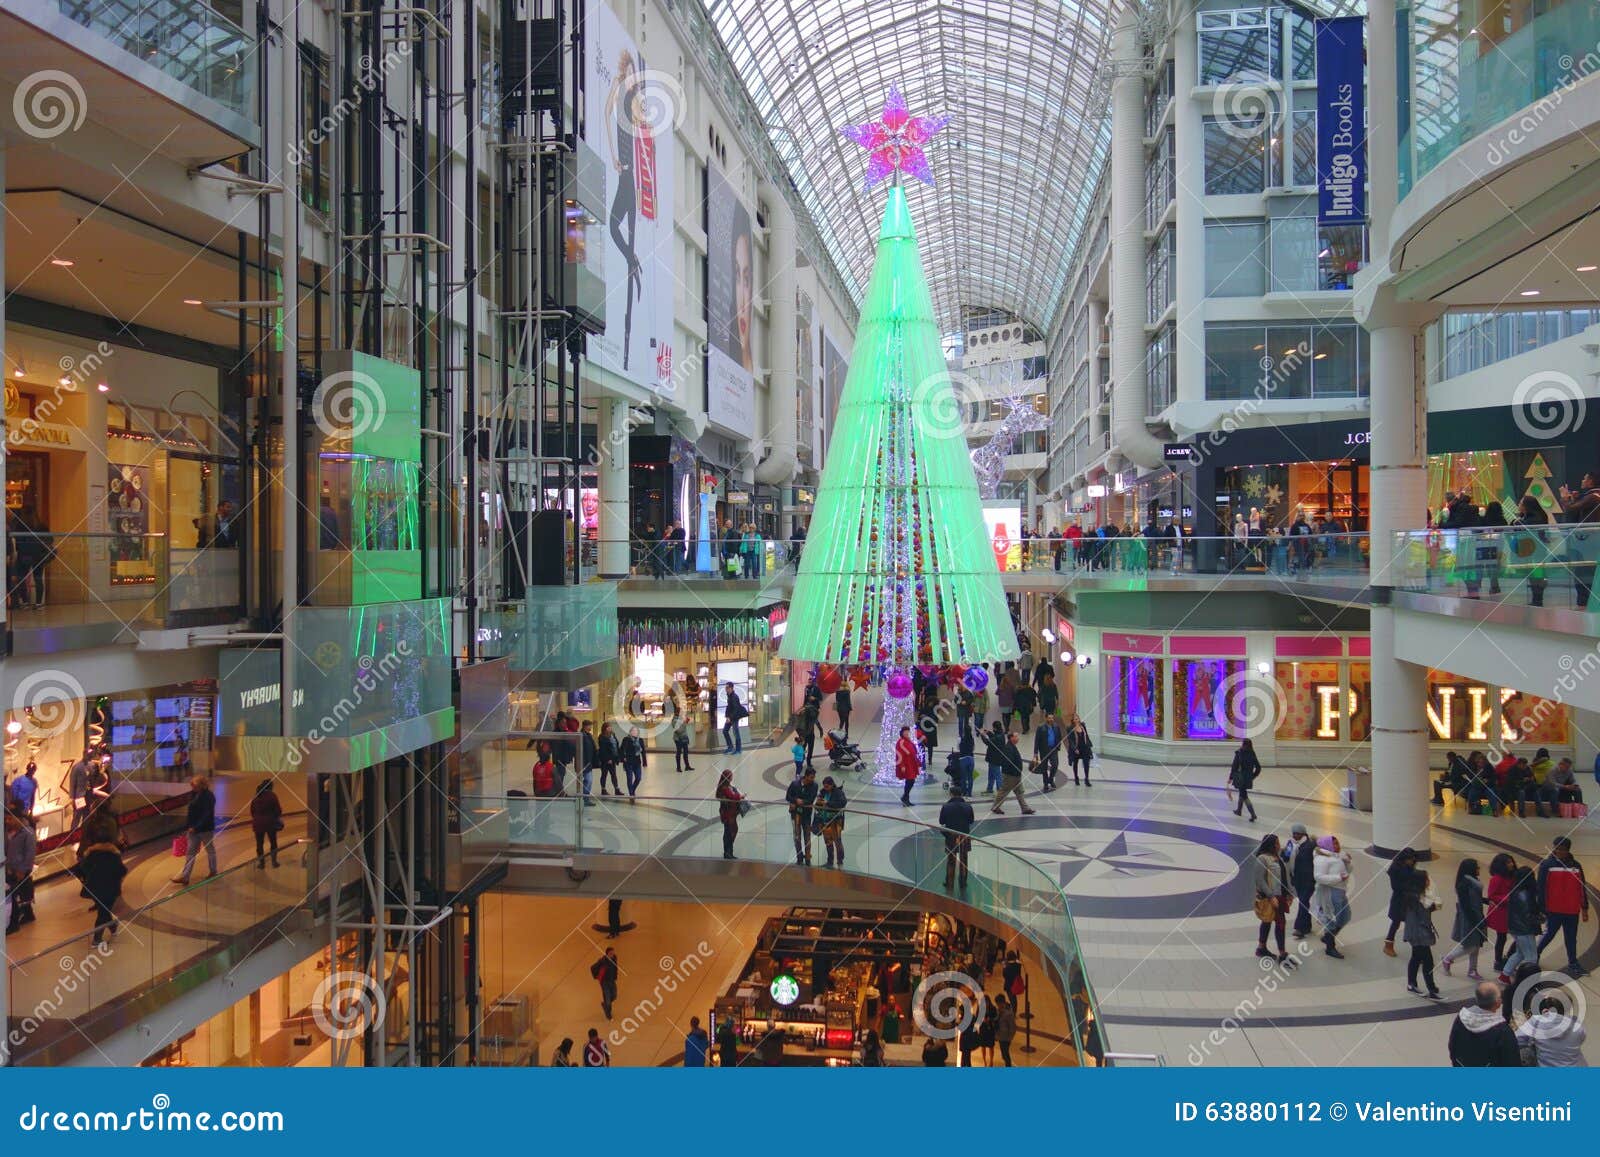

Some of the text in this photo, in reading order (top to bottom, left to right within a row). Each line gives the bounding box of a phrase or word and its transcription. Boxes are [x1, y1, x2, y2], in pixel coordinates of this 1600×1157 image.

[1325, 84, 1358, 217] Indigo Books
[1317, 686, 1518, 740] PNK
